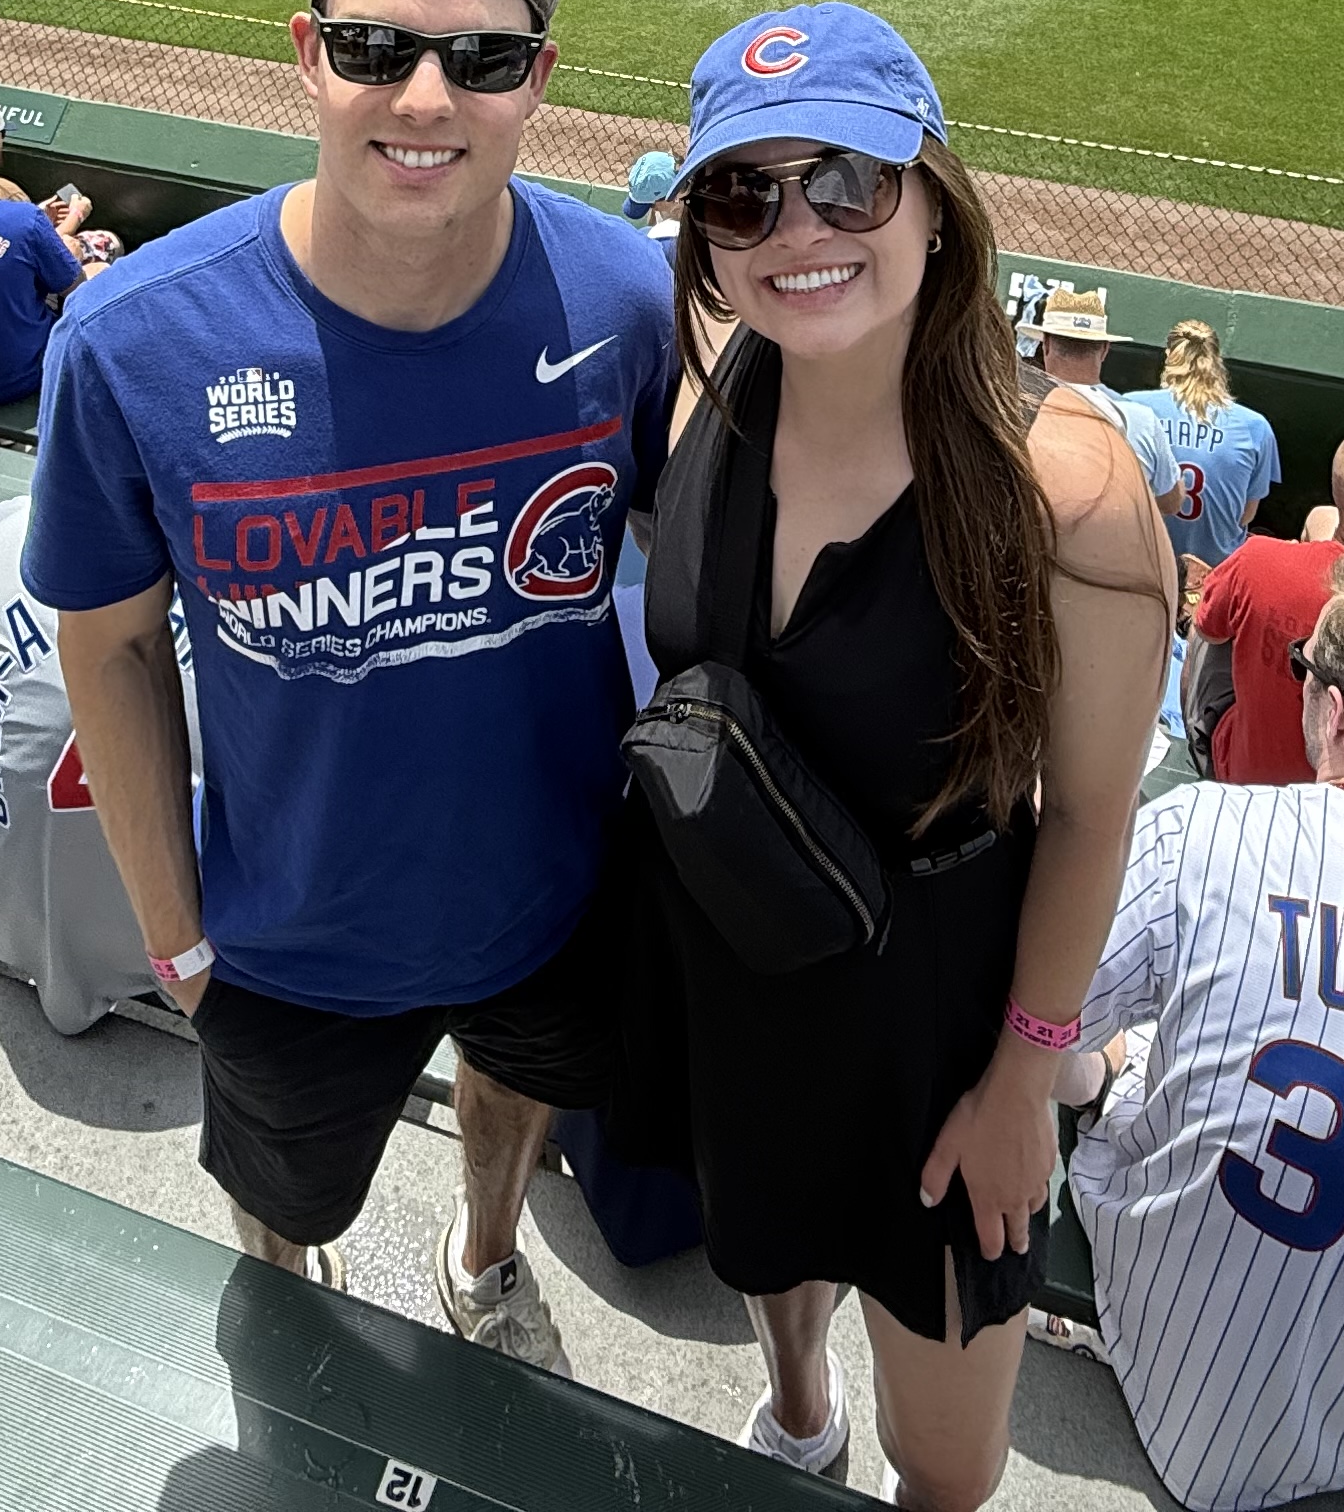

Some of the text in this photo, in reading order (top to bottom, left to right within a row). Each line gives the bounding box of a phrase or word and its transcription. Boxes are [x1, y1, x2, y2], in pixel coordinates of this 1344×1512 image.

[205, 379, 295, 406] WORLD
[208, 400, 297, 434] SERIES
[192, 478, 500, 572] LOVABLE
[197, 546, 496, 633] WINNERS
[218, 600, 276, 649] WORLD
[280, 634, 362, 659] SERIES
[1036, 1026, 1053, 1039] 21
[385, 1467, 424, 1508] 12
